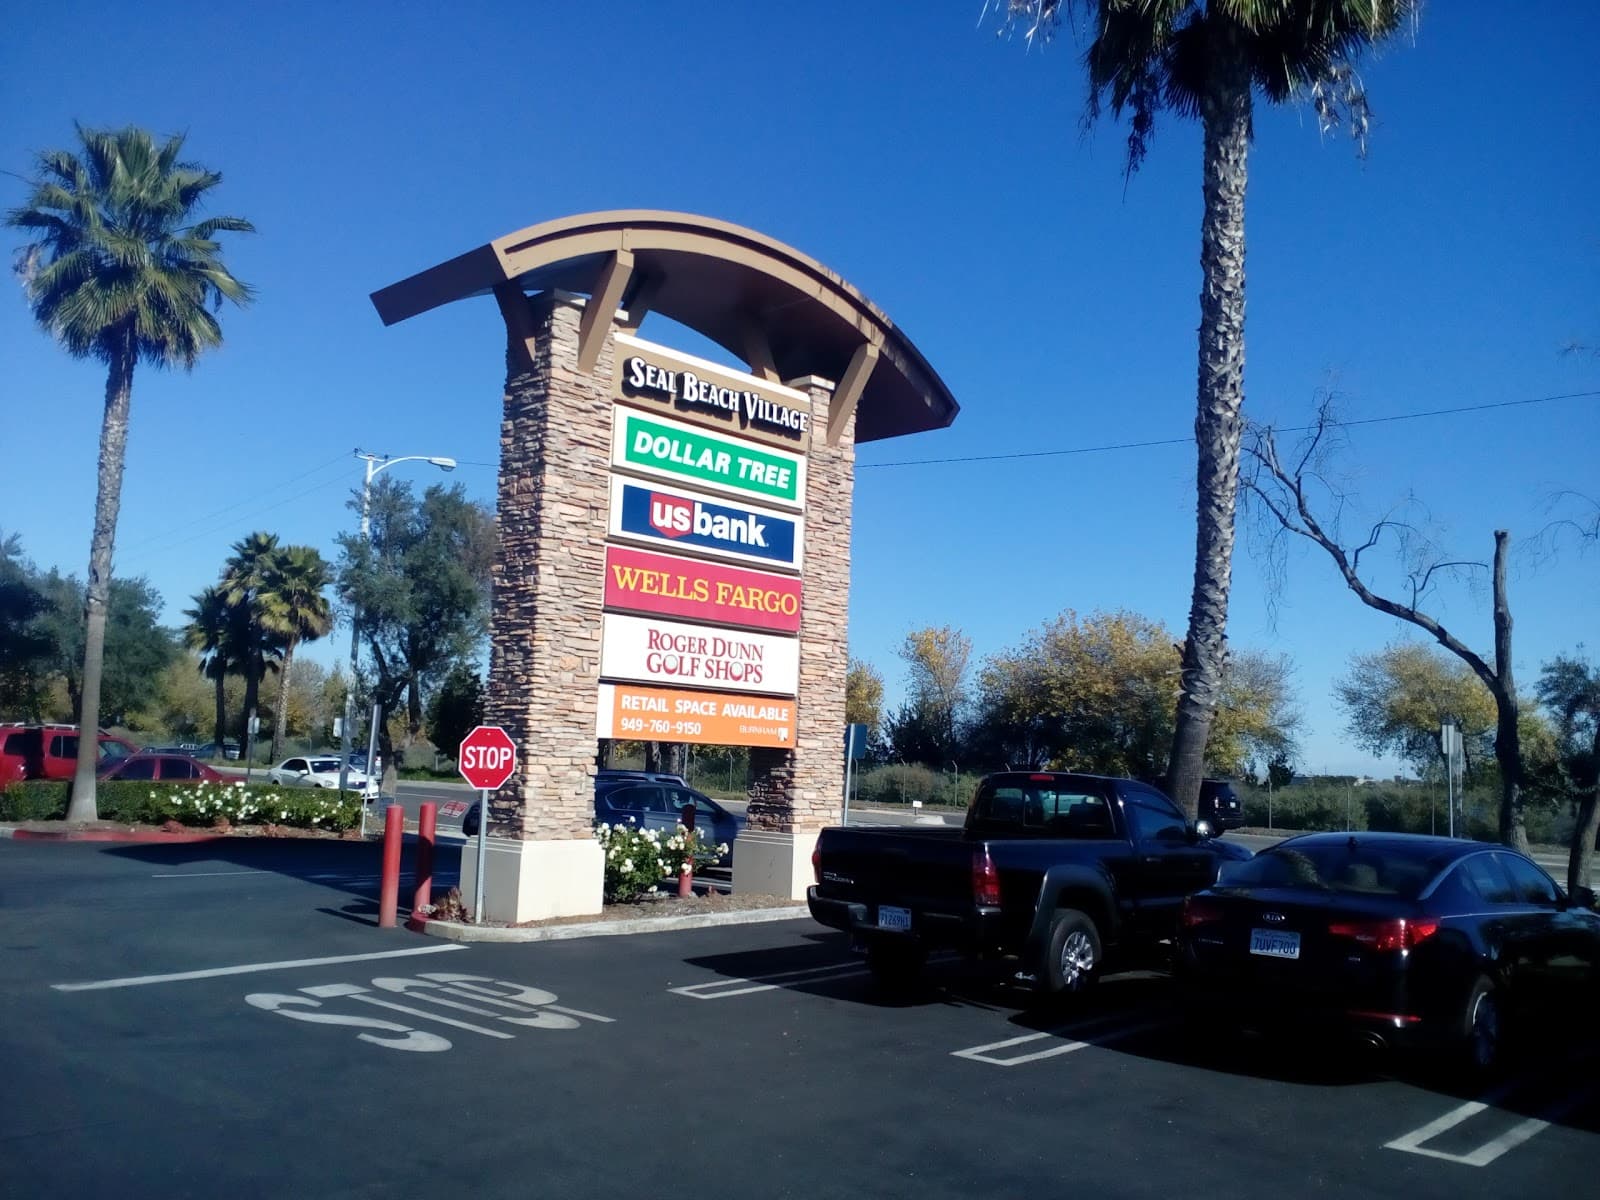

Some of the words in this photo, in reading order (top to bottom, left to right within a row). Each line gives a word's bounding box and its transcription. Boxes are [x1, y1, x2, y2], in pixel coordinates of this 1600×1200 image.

[629, 357, 678, 394] SEAL
[683, 372, 740, 412] BEACH
[743, 391, 809, 433] VILLAGE
[633, 431, 731, 475] DOLLAR
[737, 457, 791, 490] TREE
[612, 565, 709, 602] WELLS
[715, 582, 798, 616] FARGO
[647, 628, 708, 656] ROGER
[712, 637, 764, 662] DUNN
[646, 652, 701, 677] GOLF
[704, 658, 763, 684] SHOPS
[621, 694, 669, 713] RETAIL
[675, 699, 717, 717] SPACE
[722, 703, 789, 722] AVAILABLE
[620, 717, 702, 736] 949-760-9150
[463, 746, 512, 770] STOP
[1253, 935, 1297, 955] 7UVF700
[244, 972, 617, 1052] STOP
